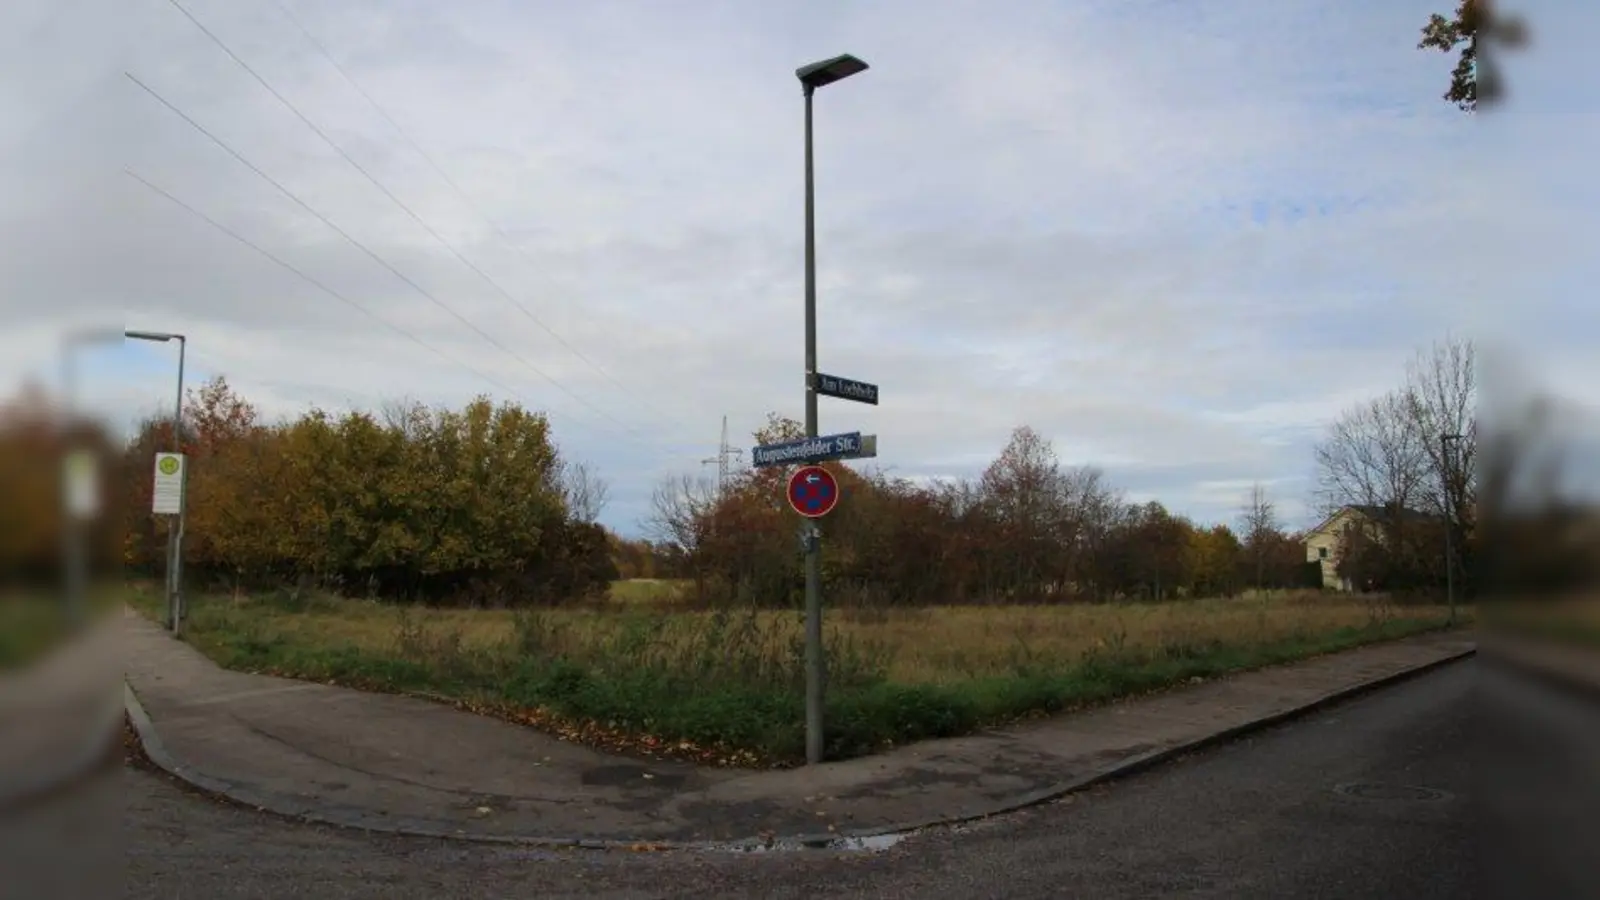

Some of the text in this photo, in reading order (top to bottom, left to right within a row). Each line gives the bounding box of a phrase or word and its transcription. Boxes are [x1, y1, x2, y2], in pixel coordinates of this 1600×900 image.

[822, 378, 837, 391] Am
[756, 436, 856, 462] Augustenfelder Str.
